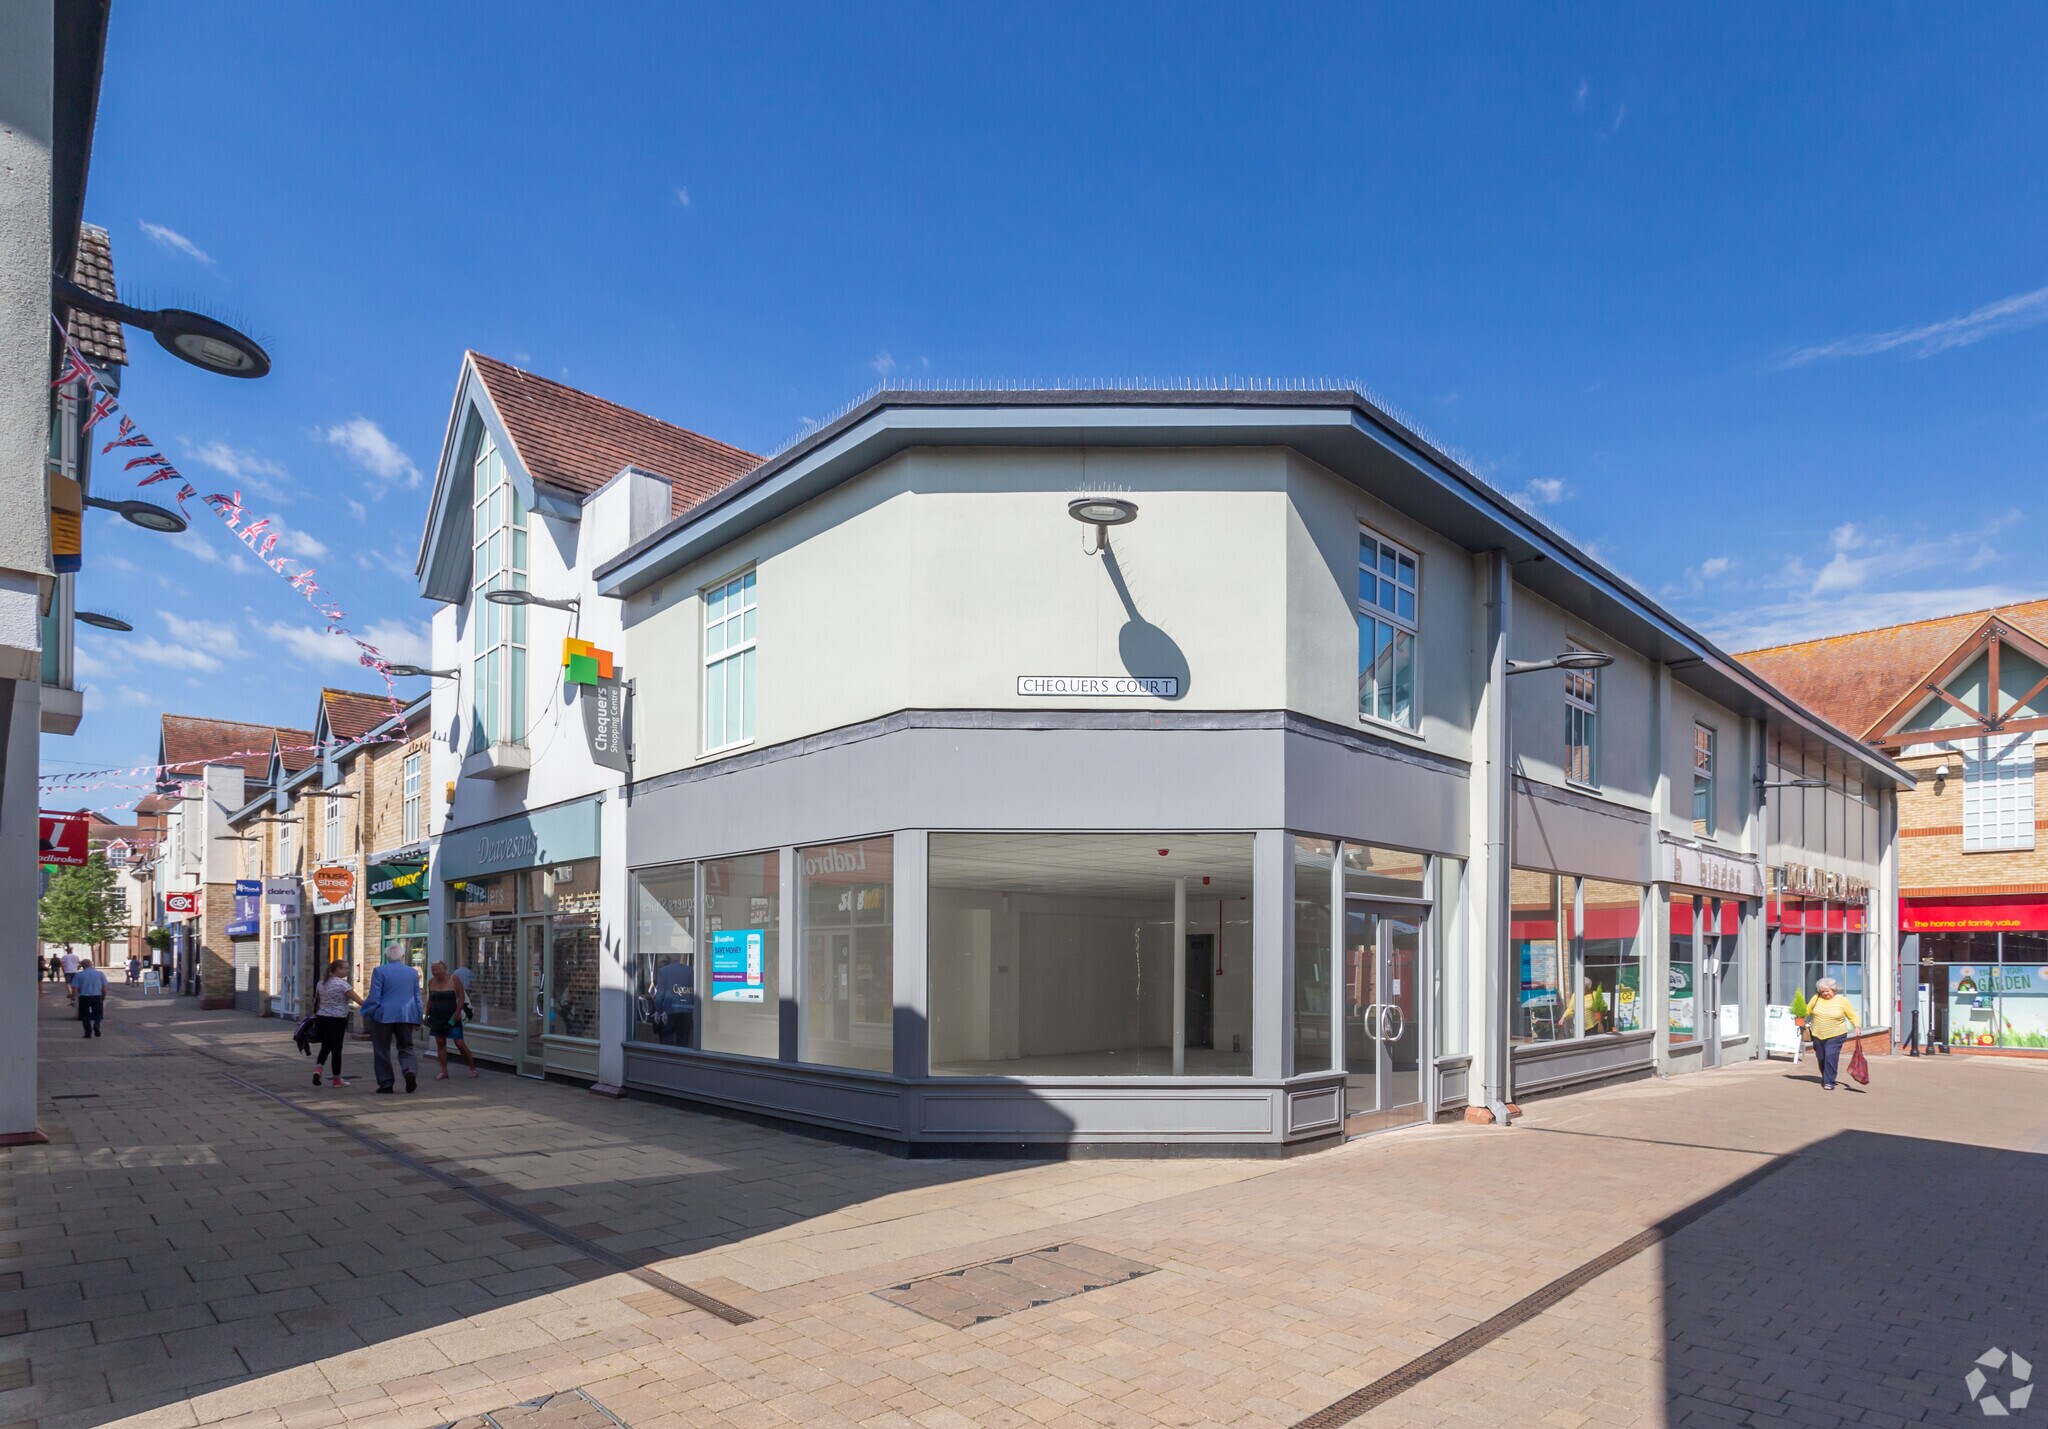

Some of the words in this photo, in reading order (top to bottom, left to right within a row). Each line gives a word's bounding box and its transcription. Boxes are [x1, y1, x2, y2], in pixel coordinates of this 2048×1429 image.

[1023, 679, 1109, 693] CHEQUERS
[1115, 680, 1172, 693] COURT
[610, 689, 618, 716] Centre
[594, 687, 611, 751] Chequers
[610, 717, 620, 753] Shopping
[39, 855, 84, 864] adbrokes
[318, 872, 349, 880] music
[369, 871, 422, 895] SUBWAY
[267, 888, 296, 896] claire's
[1968, 919, 1994, 928] family
[726, 946, 741, 954] MONEY
[1978, 975, 2031, 992] GARDEN
